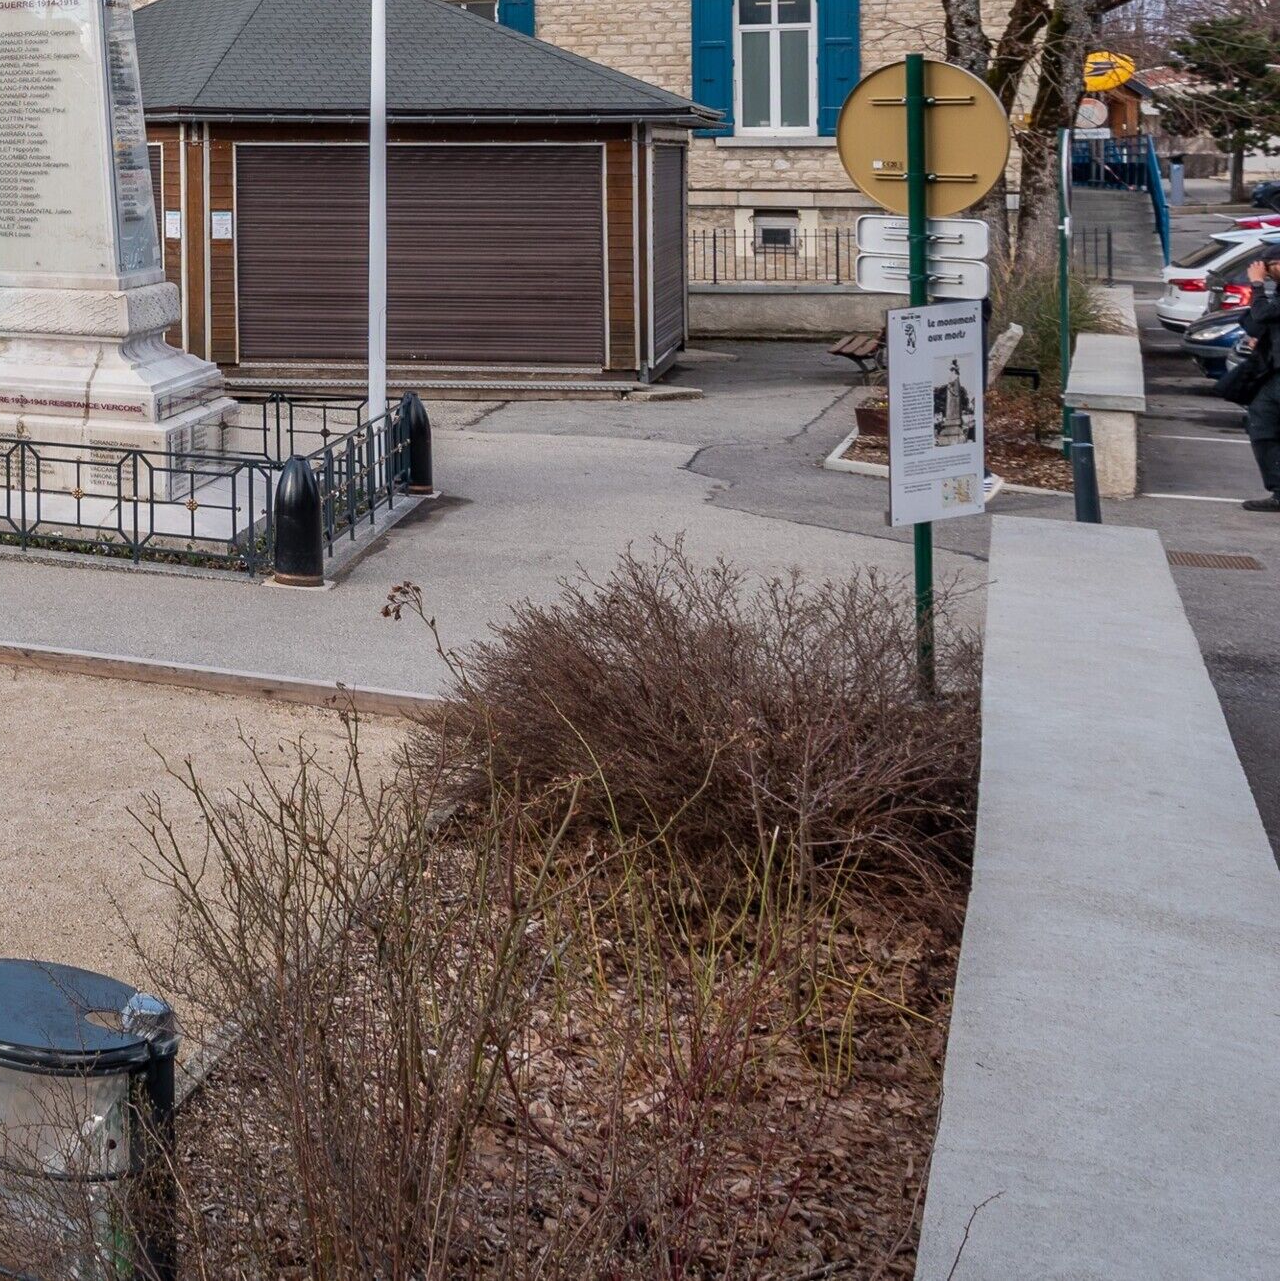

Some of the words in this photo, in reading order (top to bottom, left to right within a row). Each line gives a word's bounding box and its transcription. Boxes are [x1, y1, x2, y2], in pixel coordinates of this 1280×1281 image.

[937, 315, 976, 327] monument
[945, 330, 966, 341] morts
[11, 397, 48, 407] 1939-1945
[48, 399, 99, 410] RESISTANCE
[101, 402, 142, 413] VERCORS
